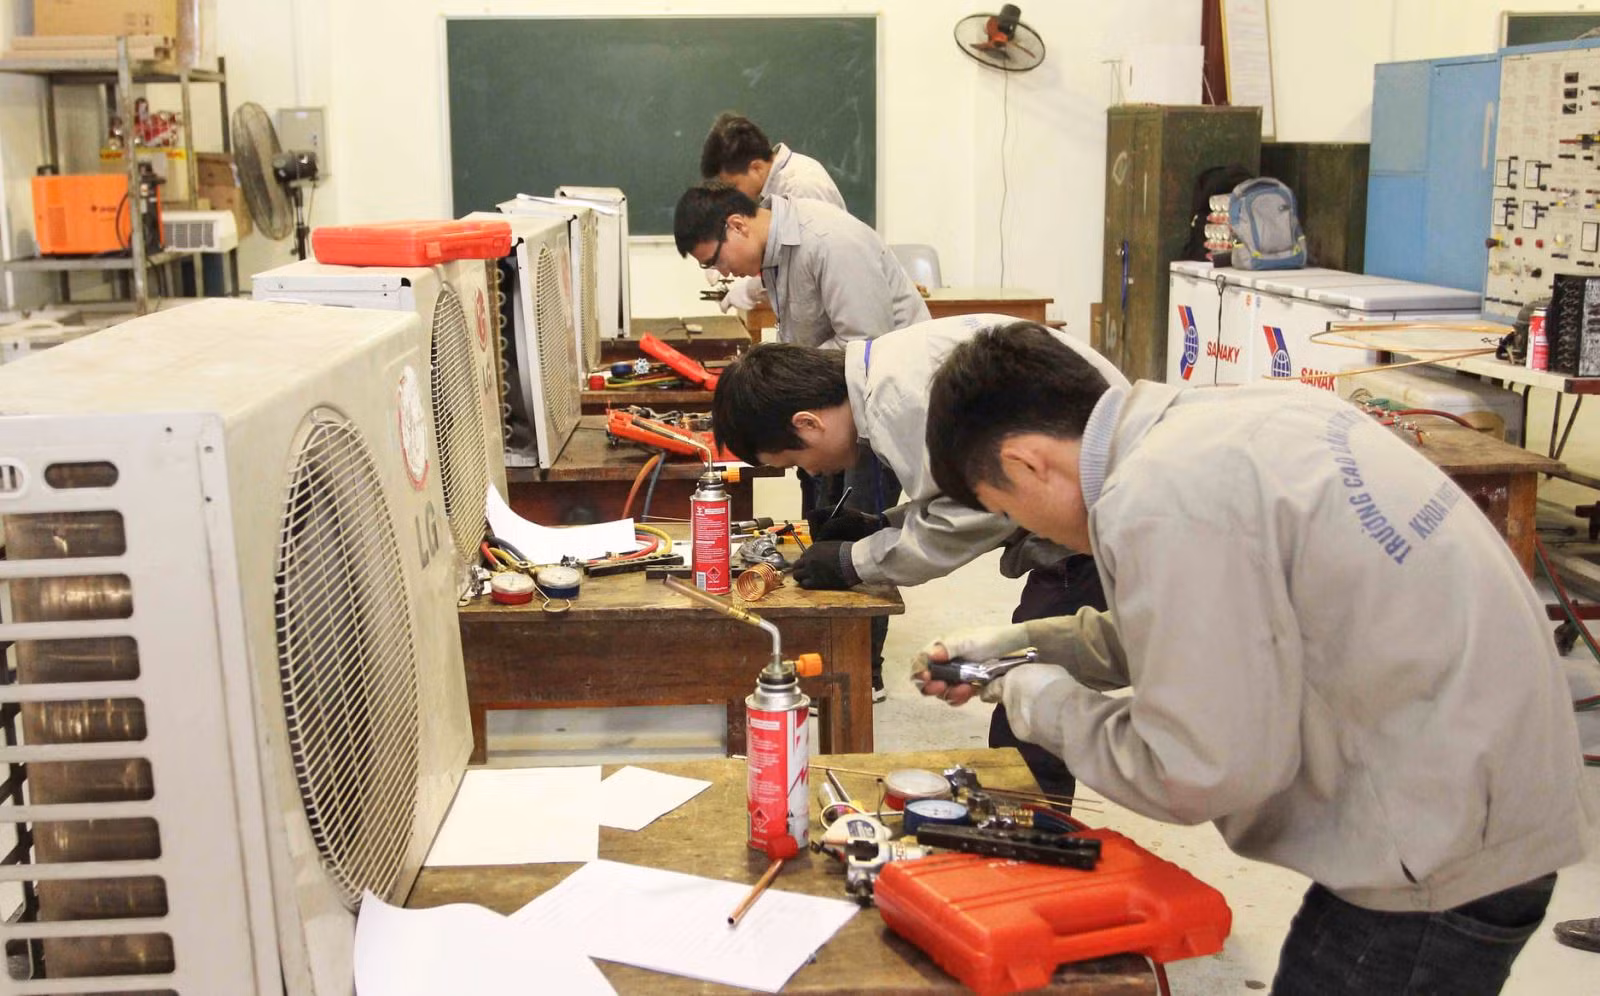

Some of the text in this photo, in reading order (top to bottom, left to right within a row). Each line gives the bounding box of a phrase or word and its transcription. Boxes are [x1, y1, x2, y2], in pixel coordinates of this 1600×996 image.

[1207, 341, 1240, 364] SANAKY
[1300, 367, 1336, 391] SANAK
[415, 500, 439, 570] LG
